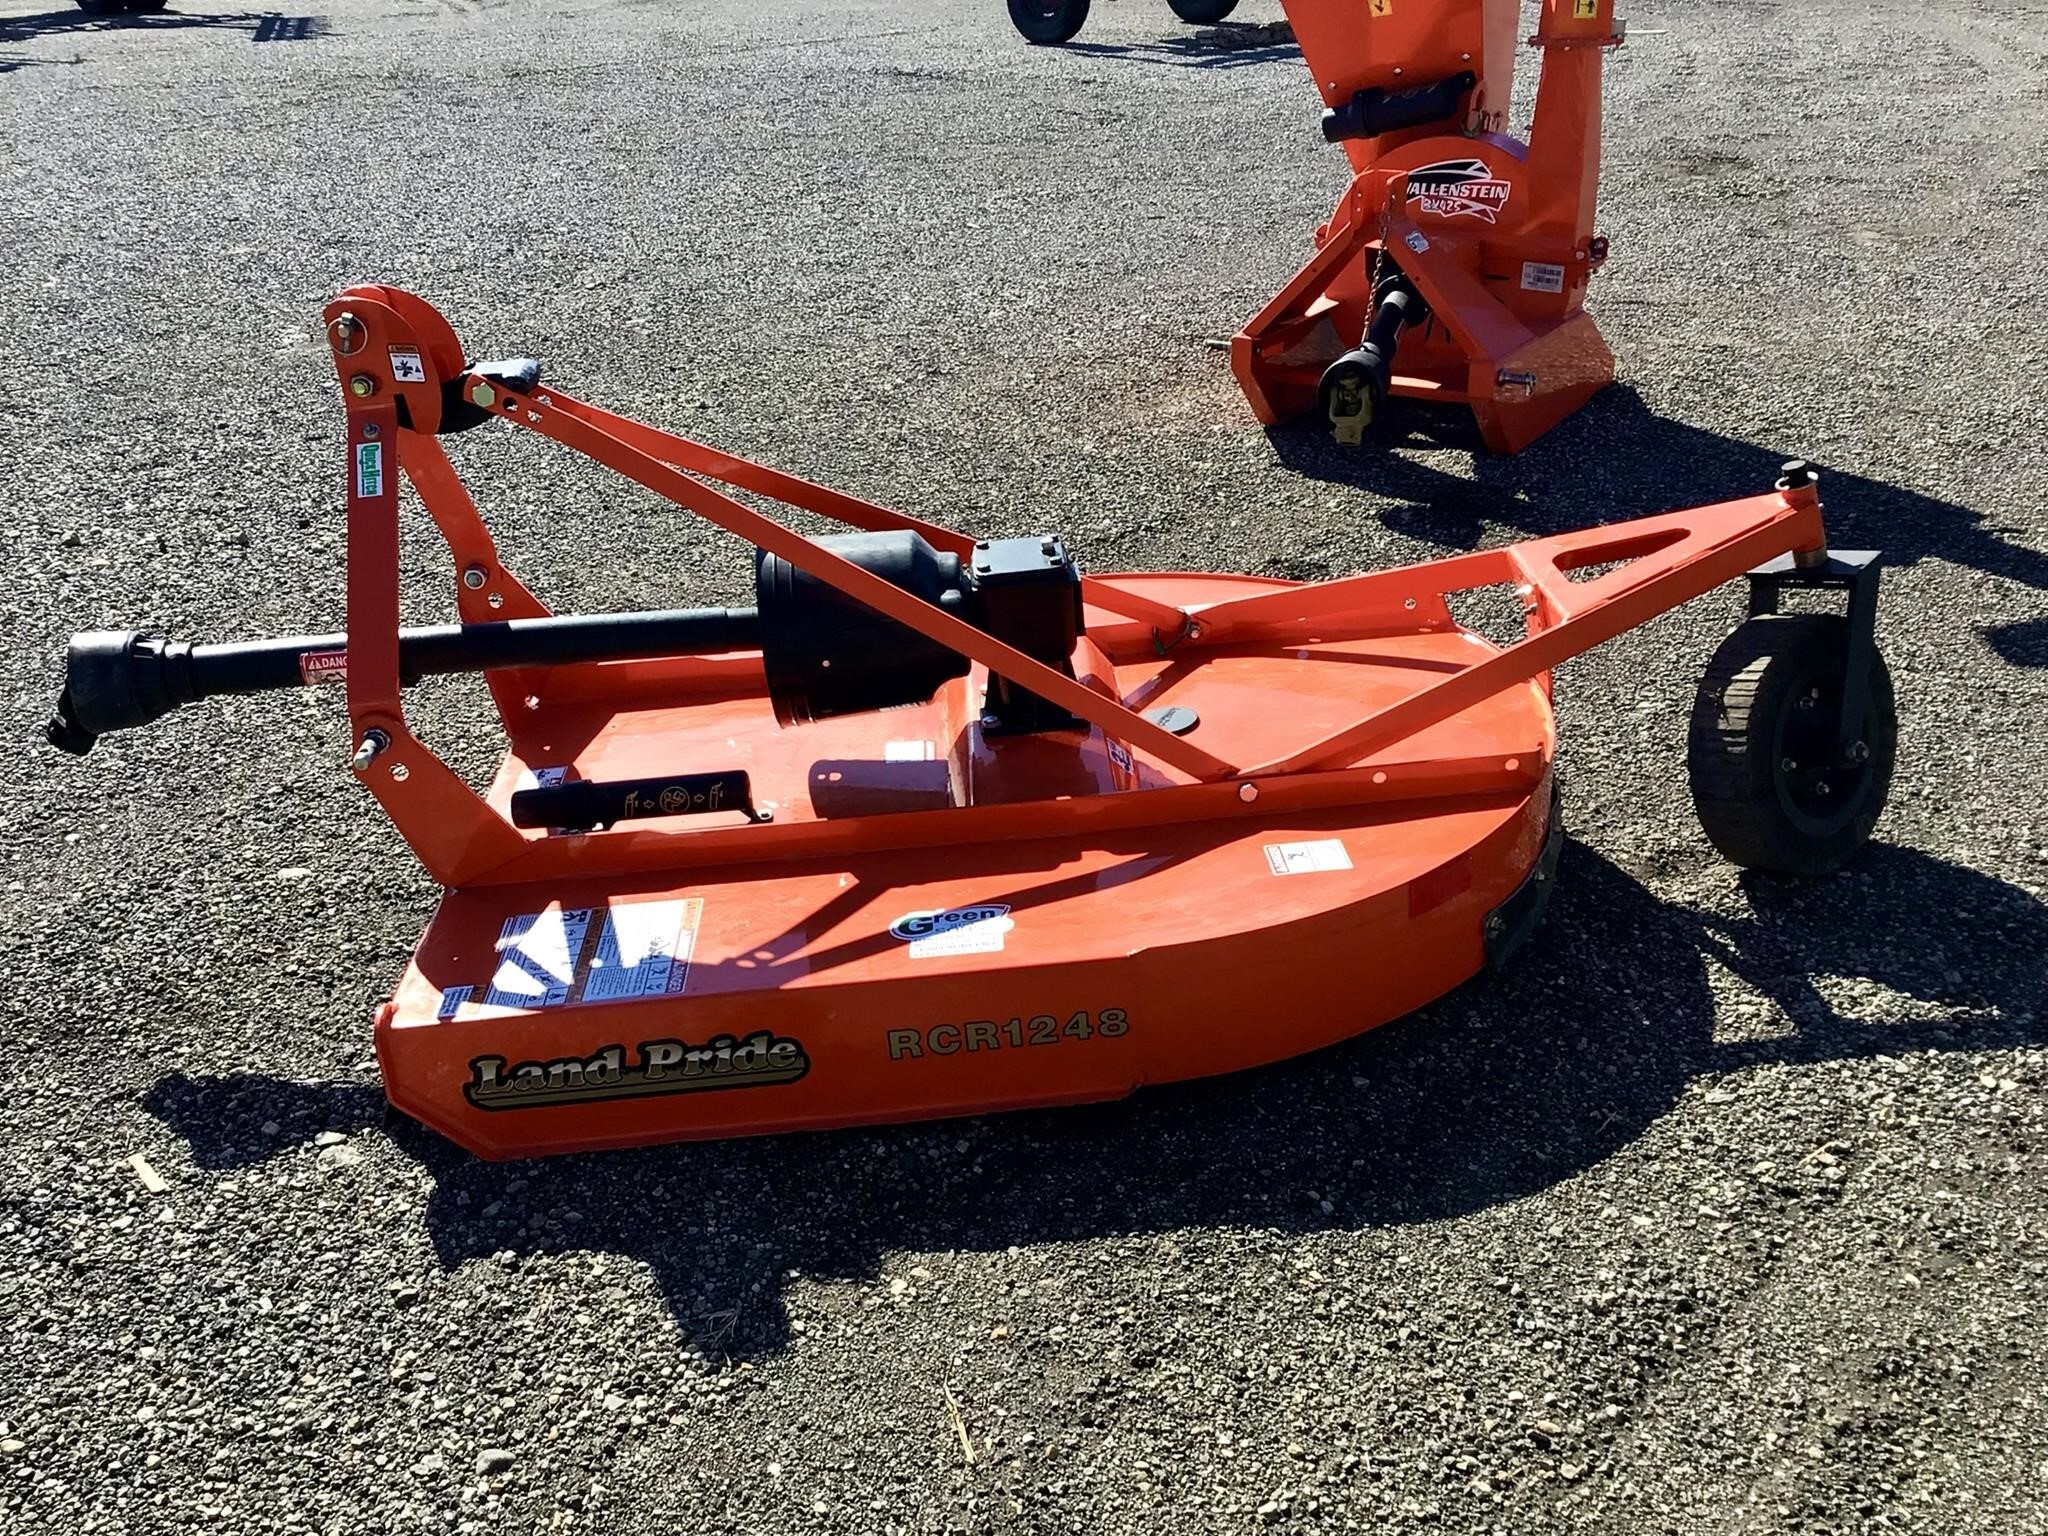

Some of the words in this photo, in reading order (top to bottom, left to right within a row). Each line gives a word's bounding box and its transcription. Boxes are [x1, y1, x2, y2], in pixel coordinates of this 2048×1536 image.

[898, 909, 996, 936] Green
[887, 1008, 1130, 1061] RCR1248
[475, 1047, 622, 1096] Land
[644, 1034, 799, 1080] Pride
